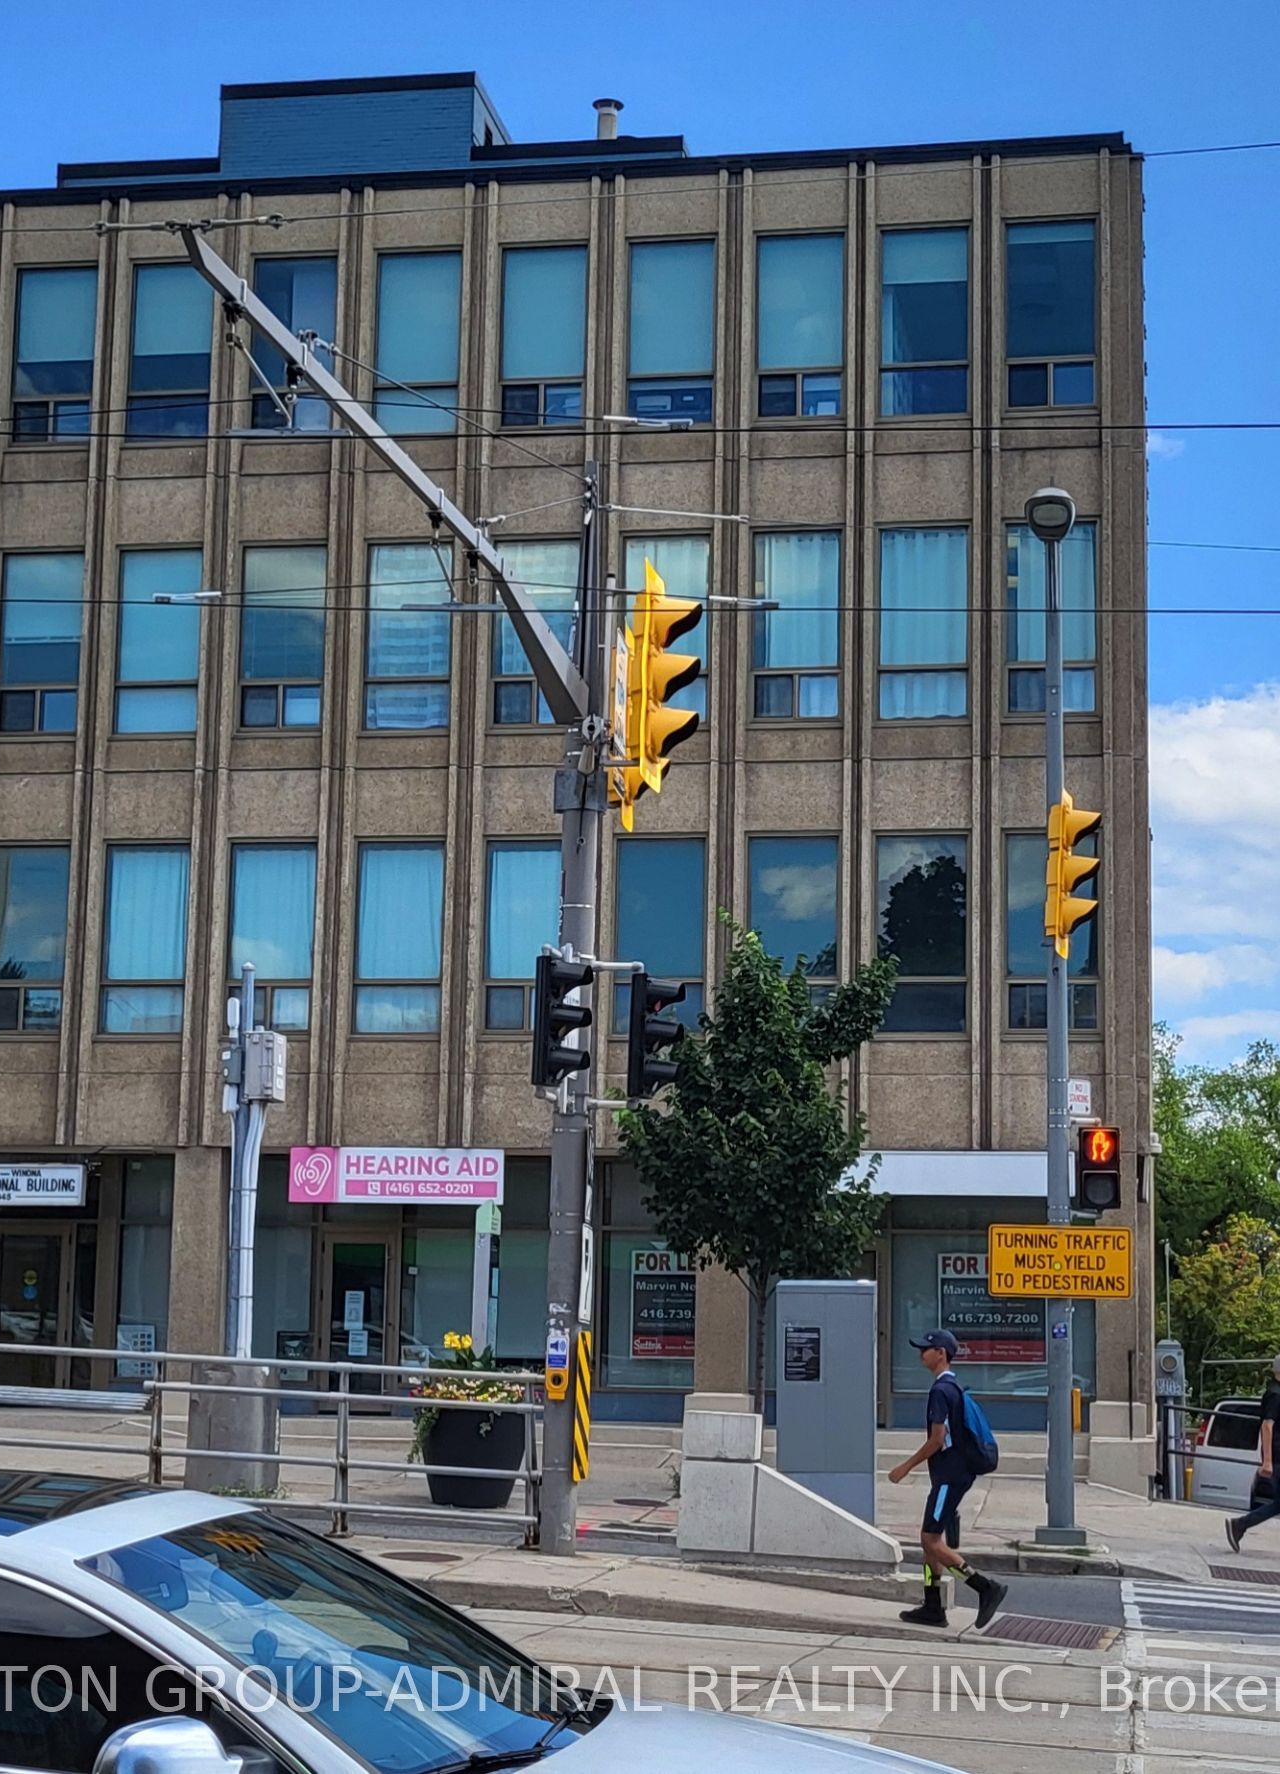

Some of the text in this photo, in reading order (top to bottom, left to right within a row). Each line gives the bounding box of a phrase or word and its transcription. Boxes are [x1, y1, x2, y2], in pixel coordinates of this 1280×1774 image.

[11, 1169, 42, 1177] WINONA
[345, 1155, 499, 1176] HEARING AID
[26, 1179, 75, 1192] BUILDING
[385, 1182, 474, 1196] (416) 652-0201
[996, 1233, 1126, 1251] TURNING TRAFFIC
[635, 1253, 671, 1272] FOR
[942, 1256, 979, 1275] FOR
[1014, 1253, 1106, 1271] MUST YIELD
[636, 1281, 677, 1291] Marvin
[943, 1284, 985, 1295] Marvin
[996, 1273, 1125, 1292] TO PEDESTRIANS
[948, 1313, 1039, 1323] 416.739.7200
